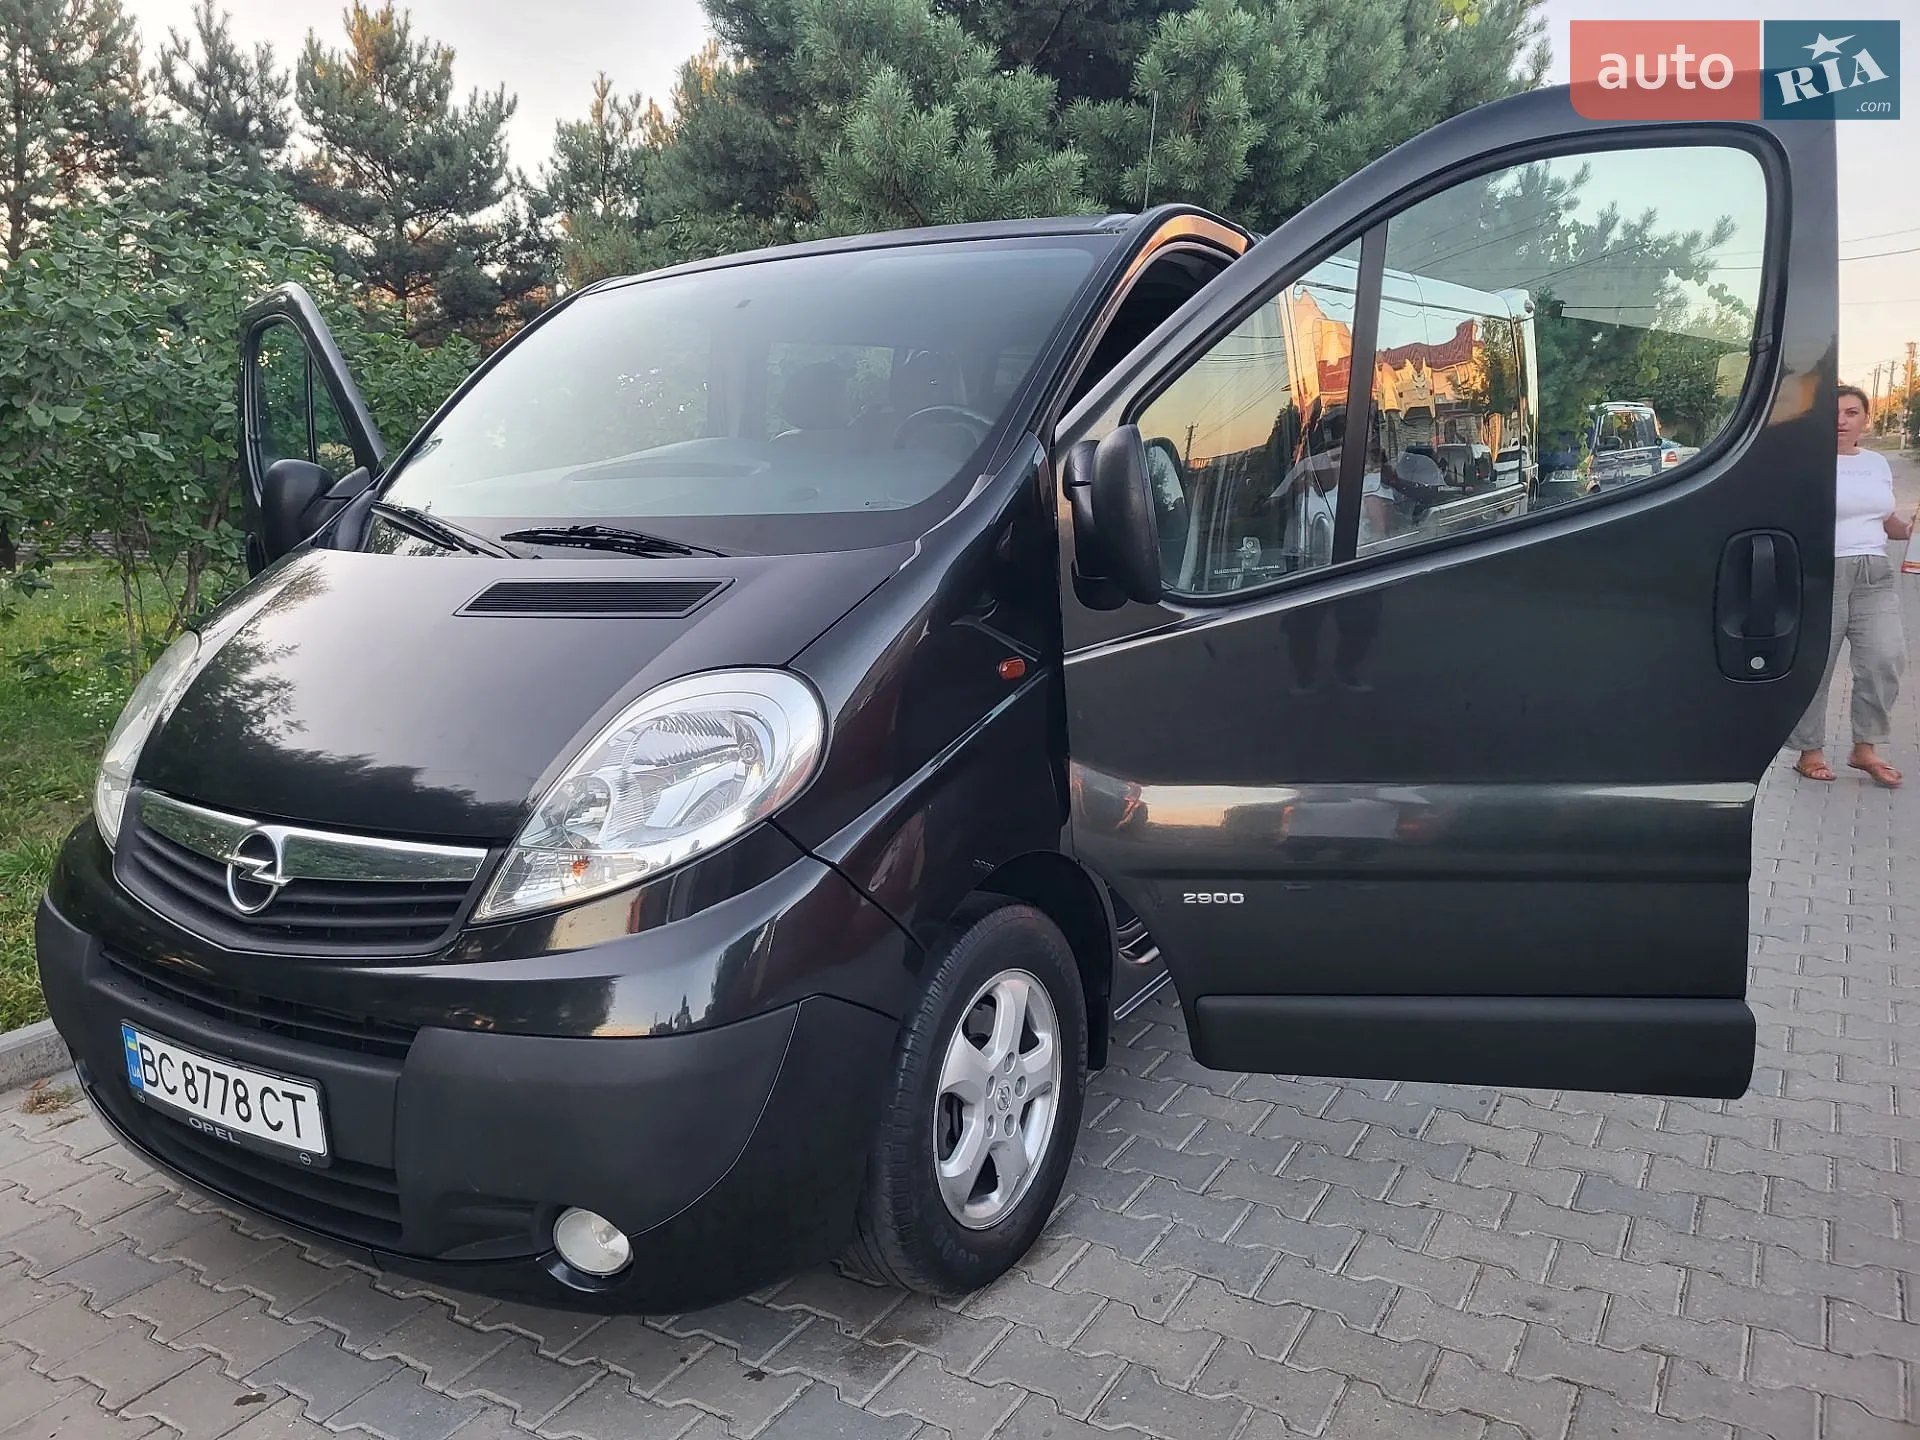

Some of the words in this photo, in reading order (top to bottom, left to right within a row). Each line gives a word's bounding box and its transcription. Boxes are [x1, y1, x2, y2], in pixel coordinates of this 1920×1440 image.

[1183, 892, 1245, 904] 2900
[132, 1066, 142, 1080] UA
[140, 1044, 178, 1095] BC
[182, 1061, 252, 1123] 8778
[260, 1086, 306, 1138] CT
[188, 1117, 241, 1145] OPEL
